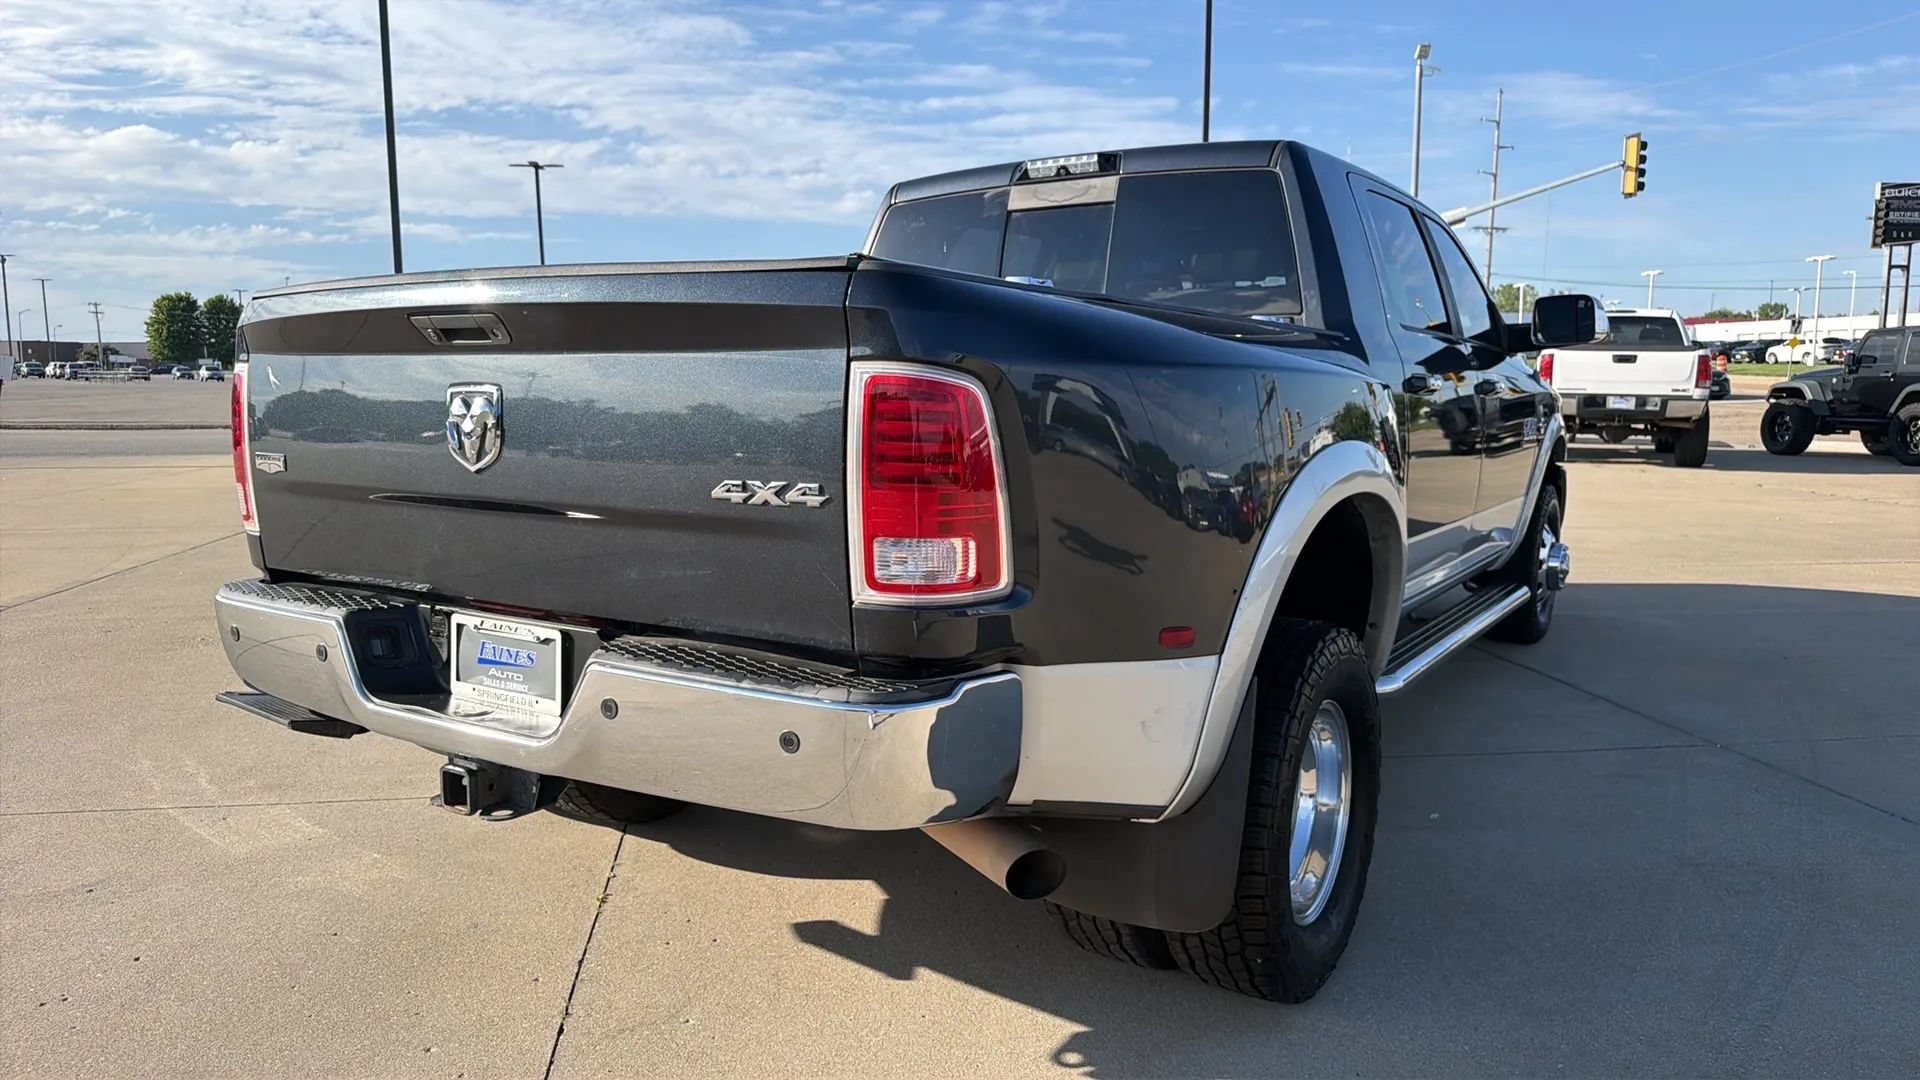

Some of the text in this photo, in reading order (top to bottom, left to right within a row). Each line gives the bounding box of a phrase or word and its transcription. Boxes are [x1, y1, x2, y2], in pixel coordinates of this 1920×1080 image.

[1885, 188, 1920, 198] BUIC
[480, 620, 535, 635] FAINE'S
[488, 668, 523, 681] AUTO
[477, 688, 527, 706] SPRINGFIELD
